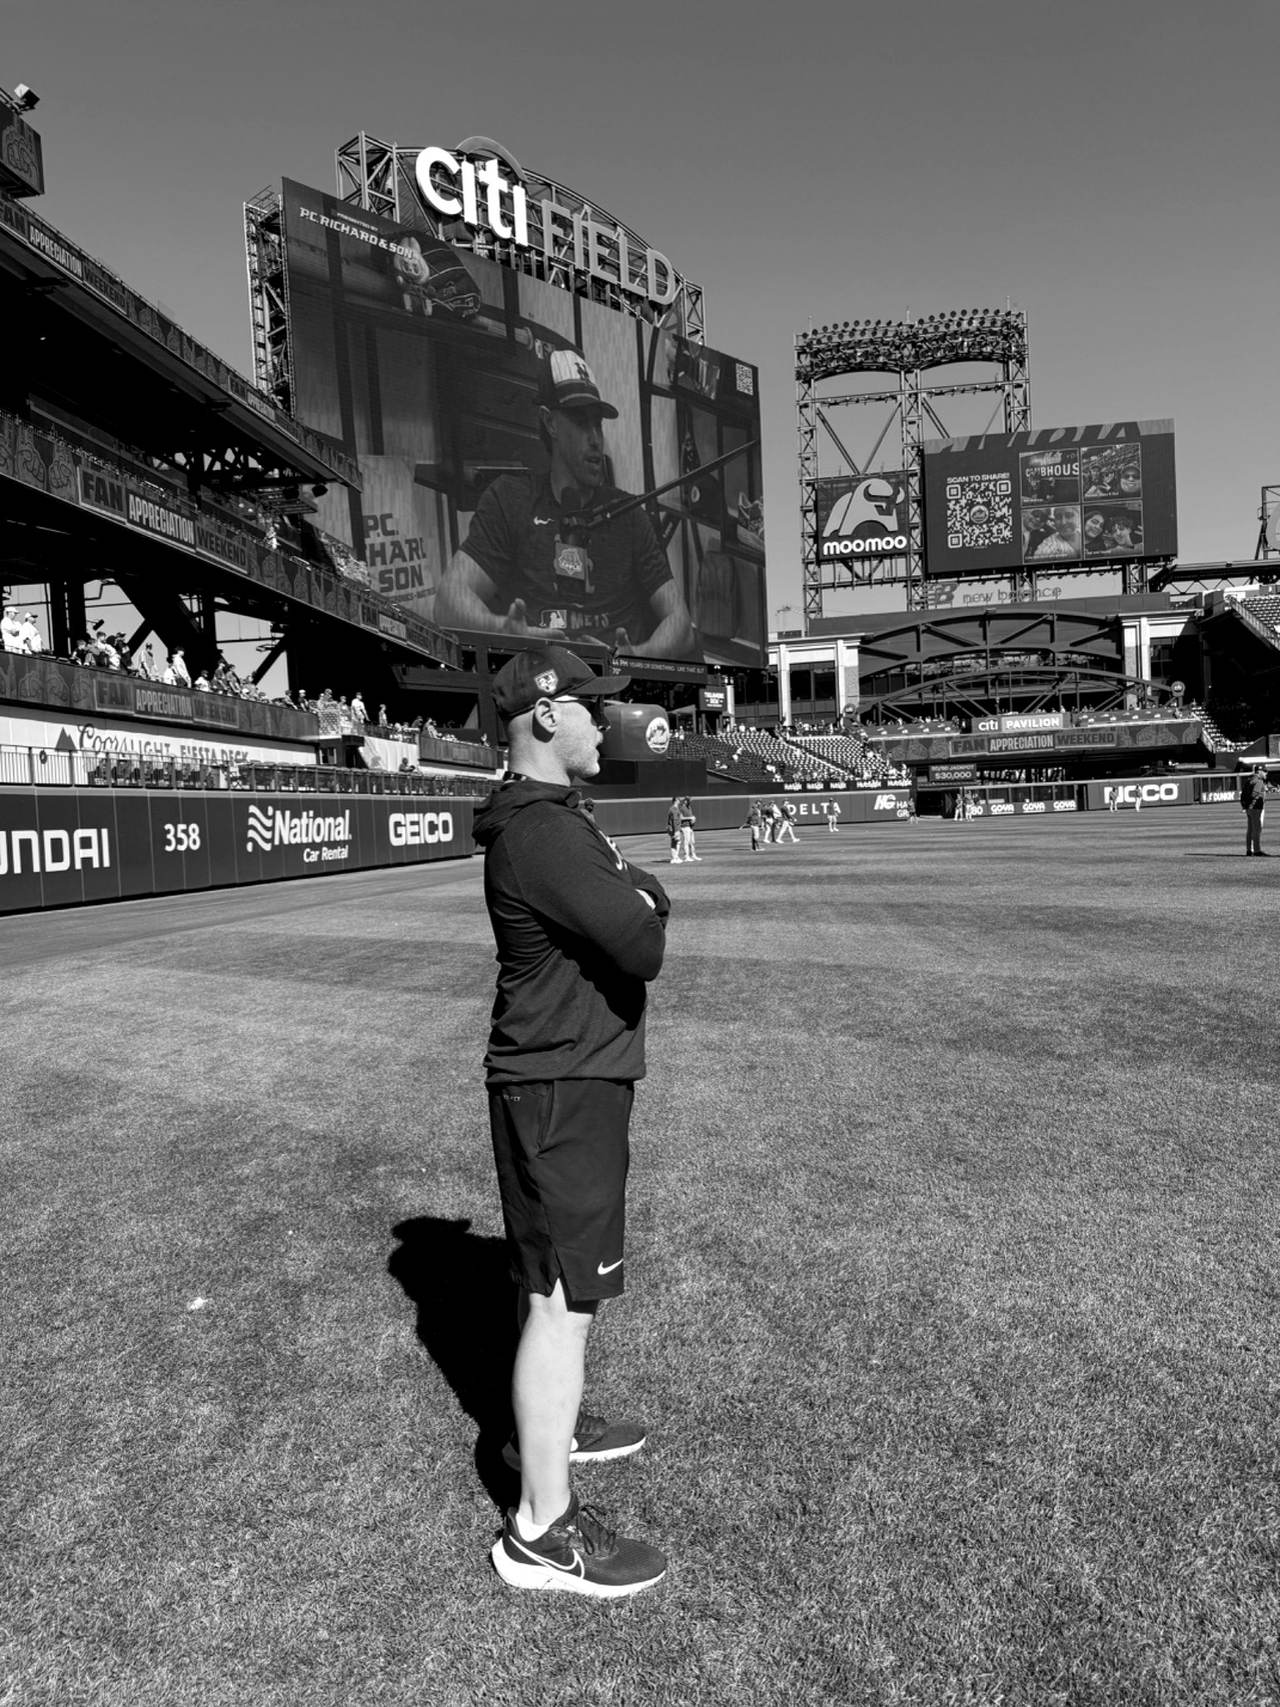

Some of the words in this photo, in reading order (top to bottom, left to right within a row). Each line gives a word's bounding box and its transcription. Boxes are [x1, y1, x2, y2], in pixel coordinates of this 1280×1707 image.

[299, 206, 319, 223] P.C.
[319, 214, 378, 246] RICHARD
[378, 238, 388, 250] &
[388, 242, 413, 259] SON
[29, 223, 83, 278] APPRECIATION
[541, 199, 676, 305] FIELD
[946, 476, 969, 484] SCAN
[82, 469, 123, 513] FAN
[128, 493, 195, 545] APPRECIATION
[199, 526, 247, 567] WEEKEND
[822, 535, 908, 556] moomoo
[378, 563, 425, 593] SON
[962, 592, 994, 604] new
[136, 688, 193, 717] APPRECIATION
[1006, 716, 1060, 730] PAVILION
[952, 739, 986, 753] FAN
[989, 734, 1054, 752] APPRECIATION
[1056, 732, 1115, 746] WEEKEND
[220, 748, 249, 766] DECK
[935, 771, 972, 780] $30,000
[1053, 800, 1077, 811] GOYA
[163, 823, 201, 852] 358
[273, 809, 350, 846] National
[388, 812, 454, 847] GEICO
[303, 848, 320, 863] Car
[321, 845, 349, 861] Rental
